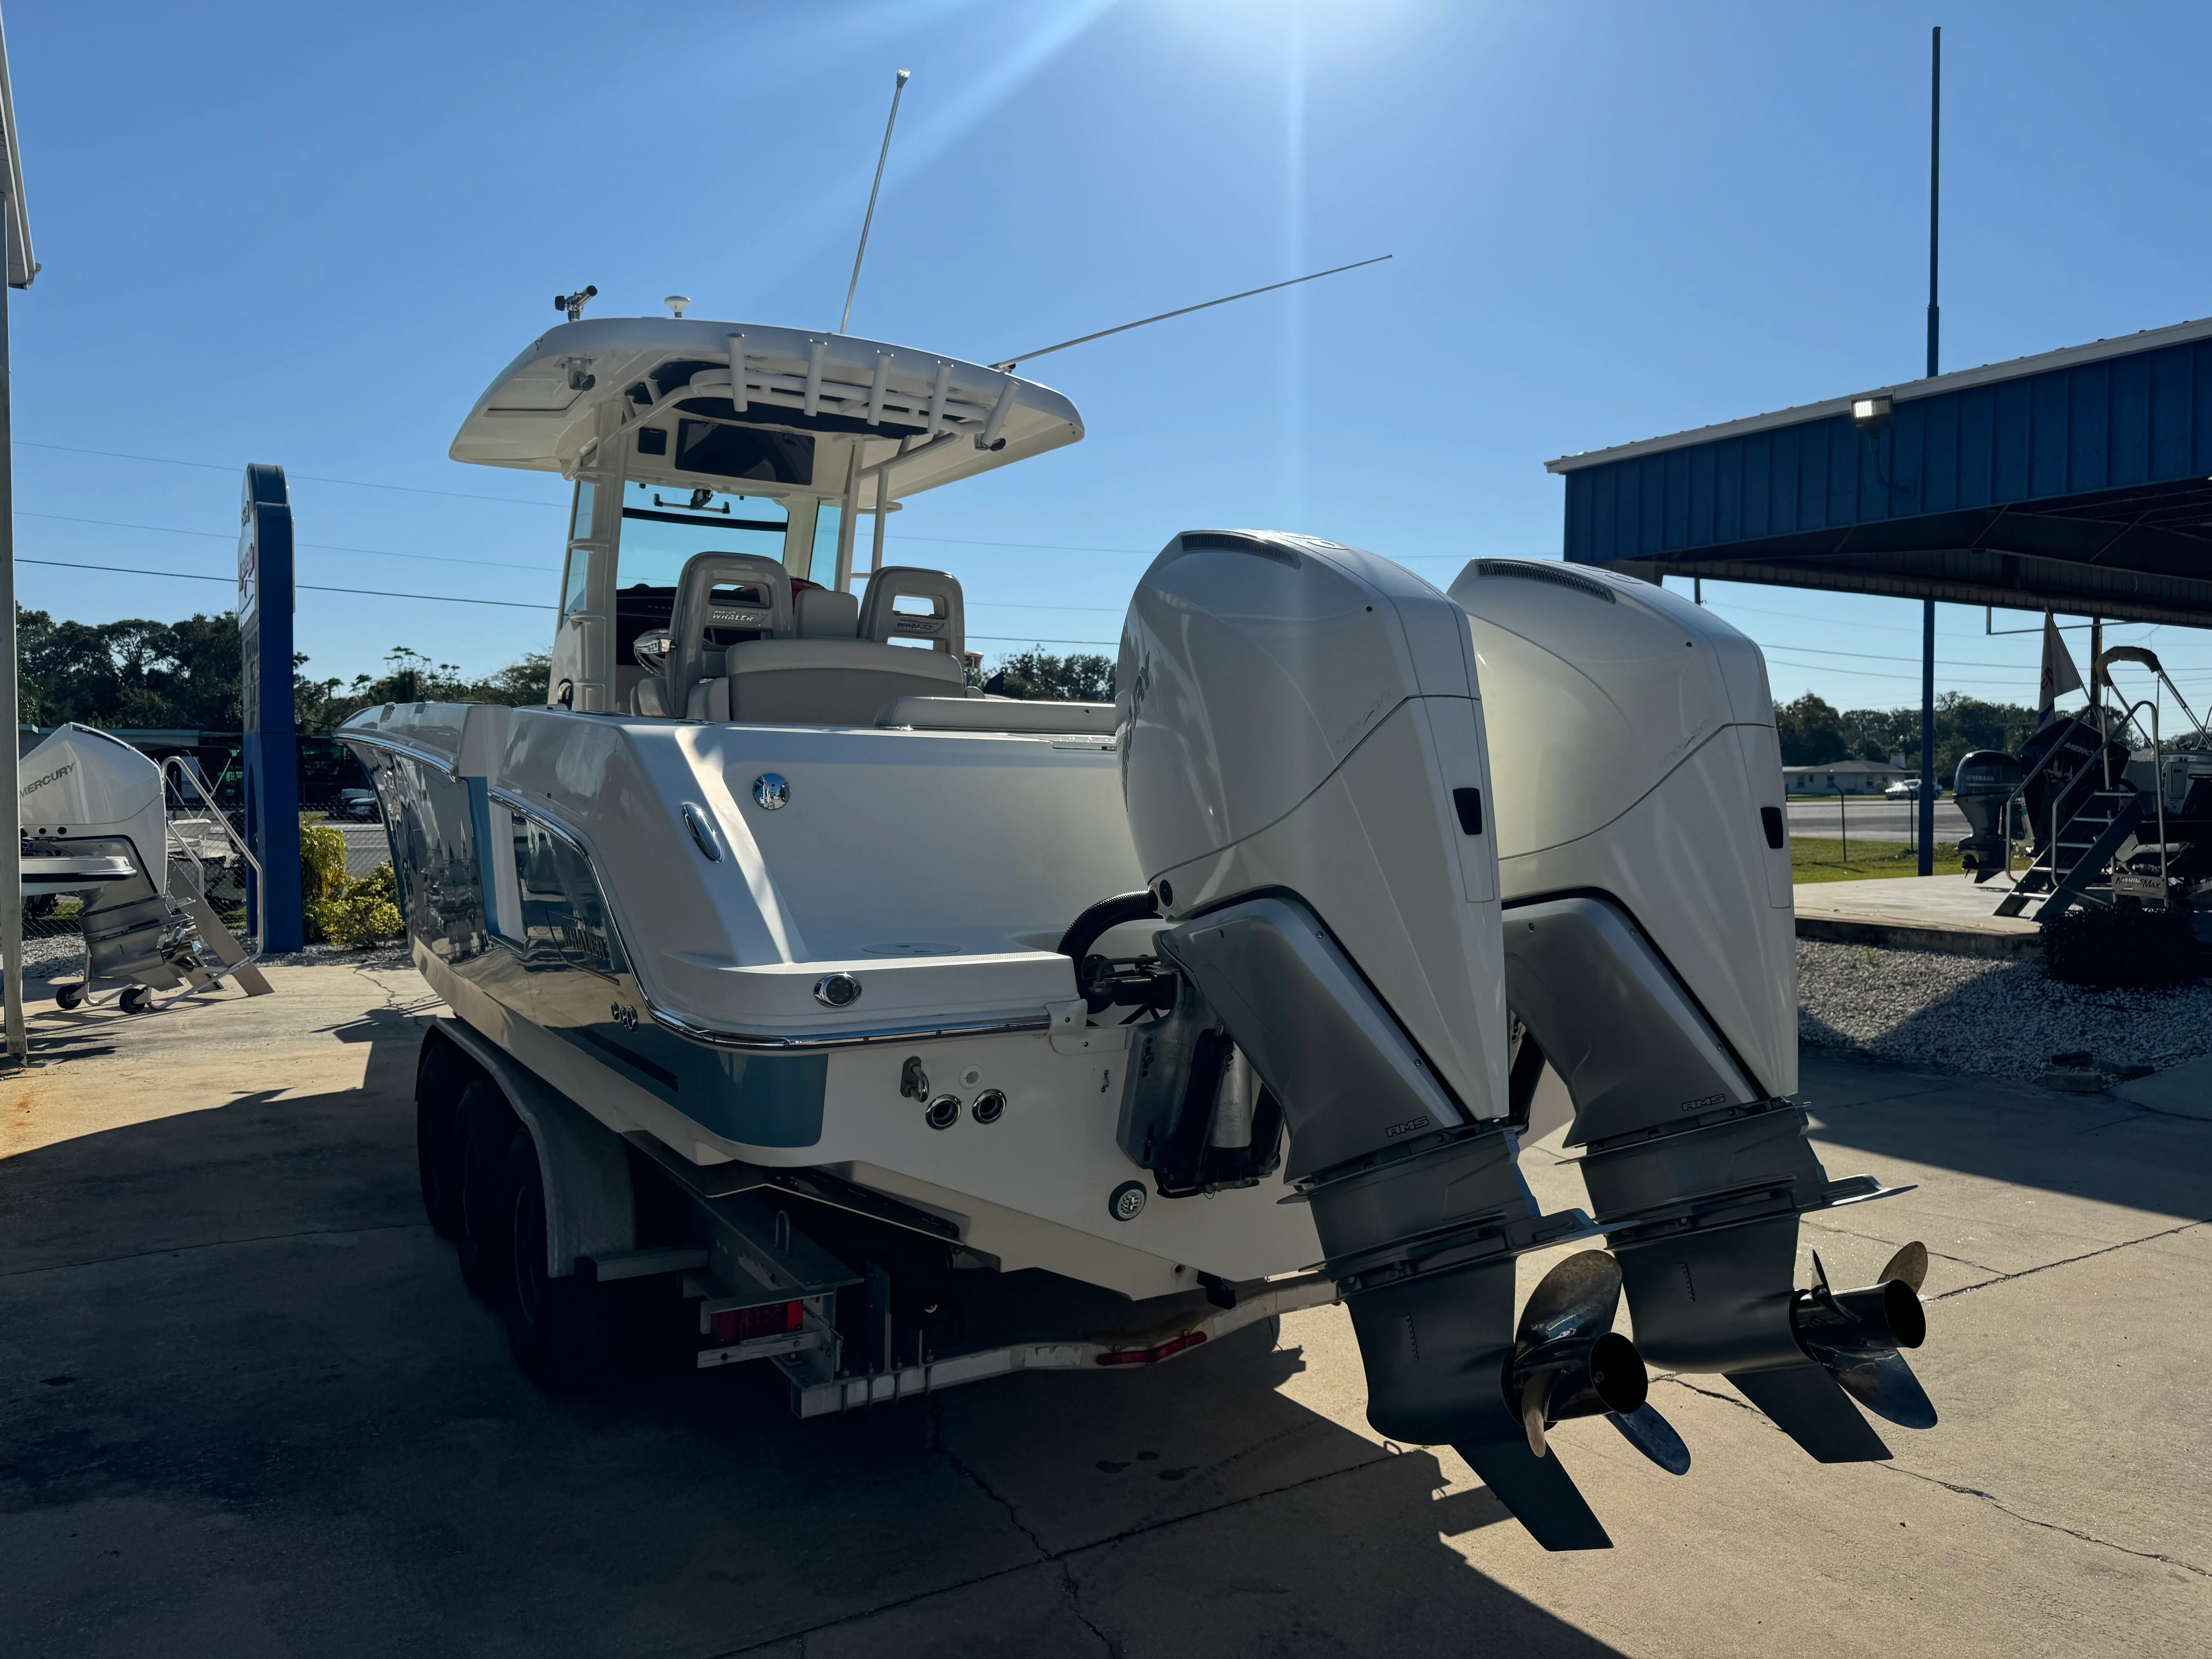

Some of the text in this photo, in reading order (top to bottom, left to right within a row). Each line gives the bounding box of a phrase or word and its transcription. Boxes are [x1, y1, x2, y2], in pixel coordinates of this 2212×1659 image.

[19, 762, 75, 799] MERCURY
[1682, 1094, 1726, 1111] AMS
[1386, 1116, 1429, 1137] AMS
